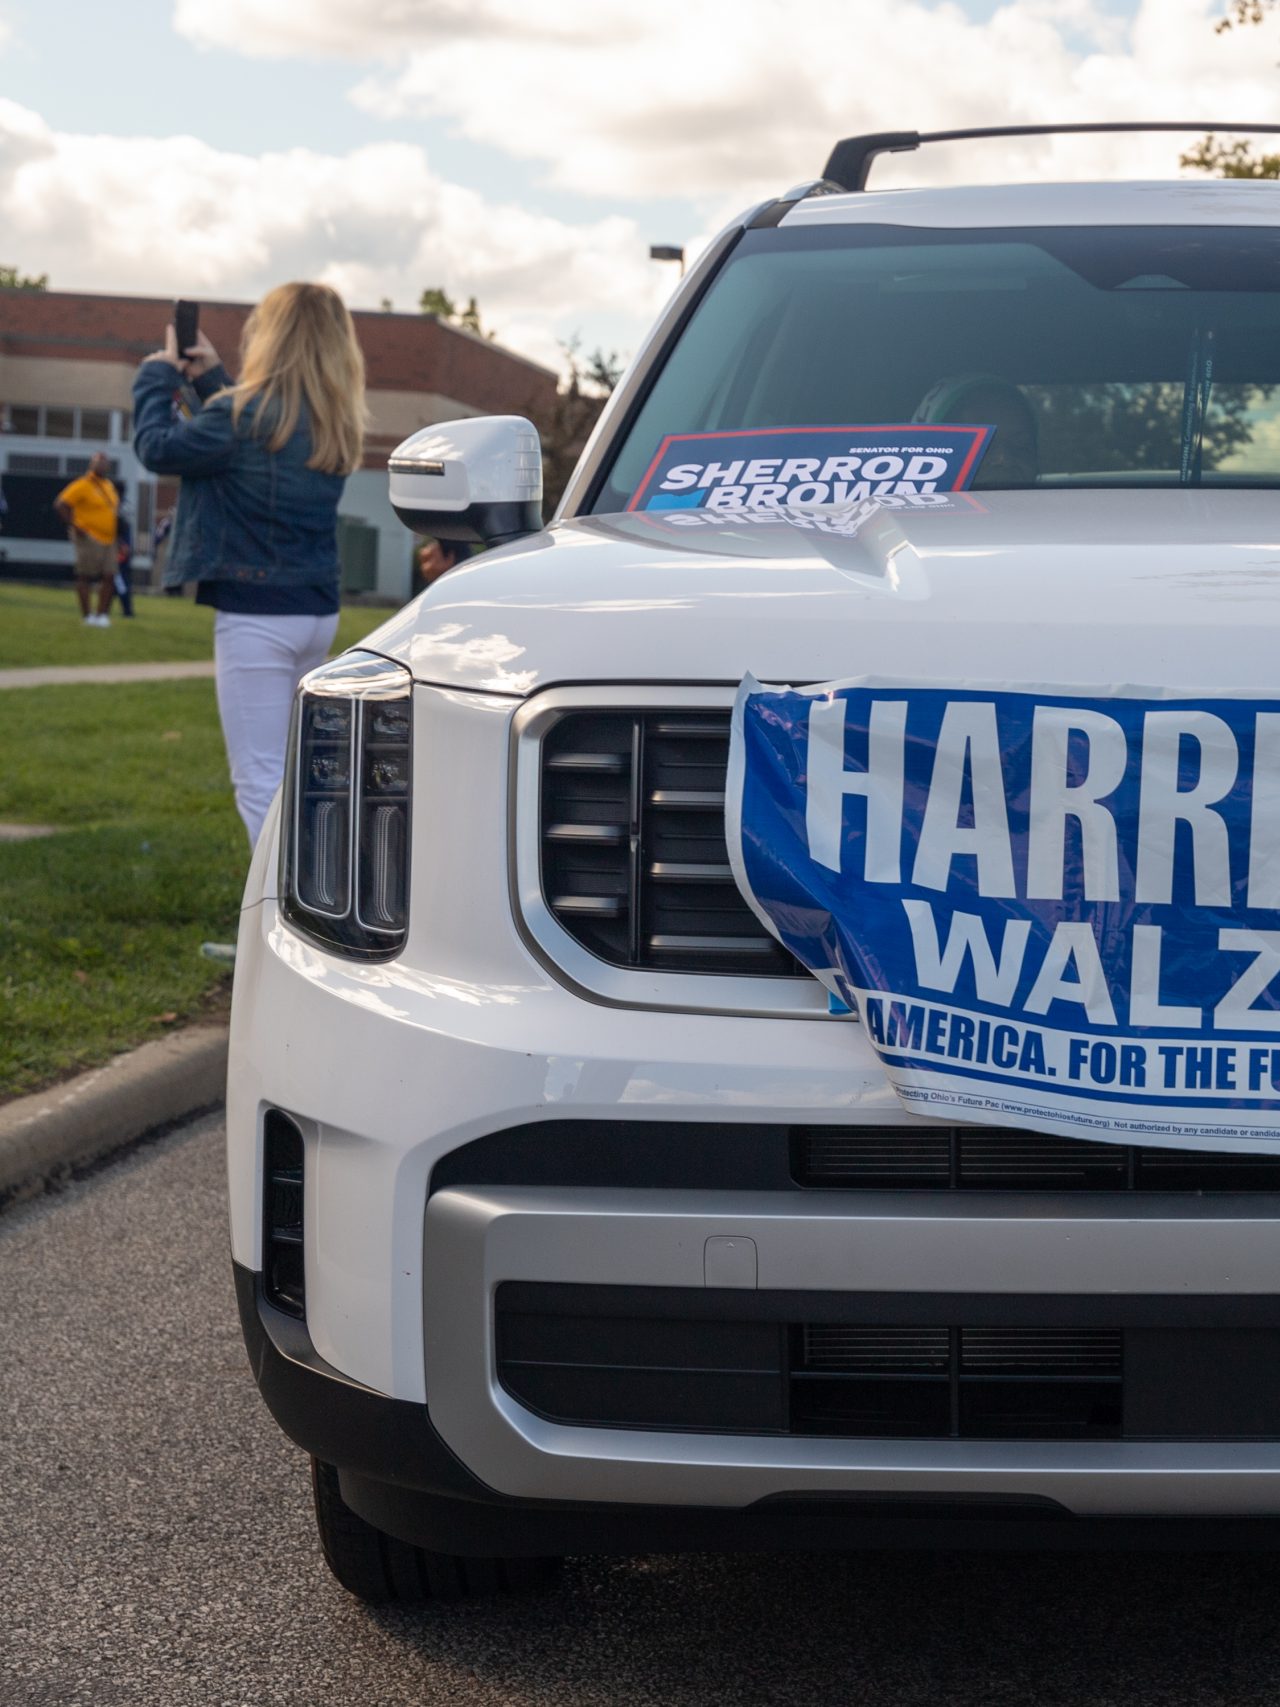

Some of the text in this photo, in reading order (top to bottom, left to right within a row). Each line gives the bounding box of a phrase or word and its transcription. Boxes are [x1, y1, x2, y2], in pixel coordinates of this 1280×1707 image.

[849, 446, 954, 454] SENATOR FOR OHIO
[659, 455, 948, 490] SHERROD
[866, 997, 1056, 1077] AMERICA.
[1069, 1037, 1147, 1089] FOR
[1158, 1044, 1236, 1091] THE
[931, 1092, 956, 1102] Ohio's
[958, 1095, 983, 1106] Future
[985, 1099, 999, 1108] Pac
[1001, 1103, 1110, 1128] (www.protectohiosfuture.org)
[1114, 1120, 1128, 1129] Not
[1130, 1122, 1170, 1132] authorized
[1173, 1124, 1181, 1134] by
[1184, 1127, 1198, 1136] any
[1200, 1127, 1238, 1136] candidate
